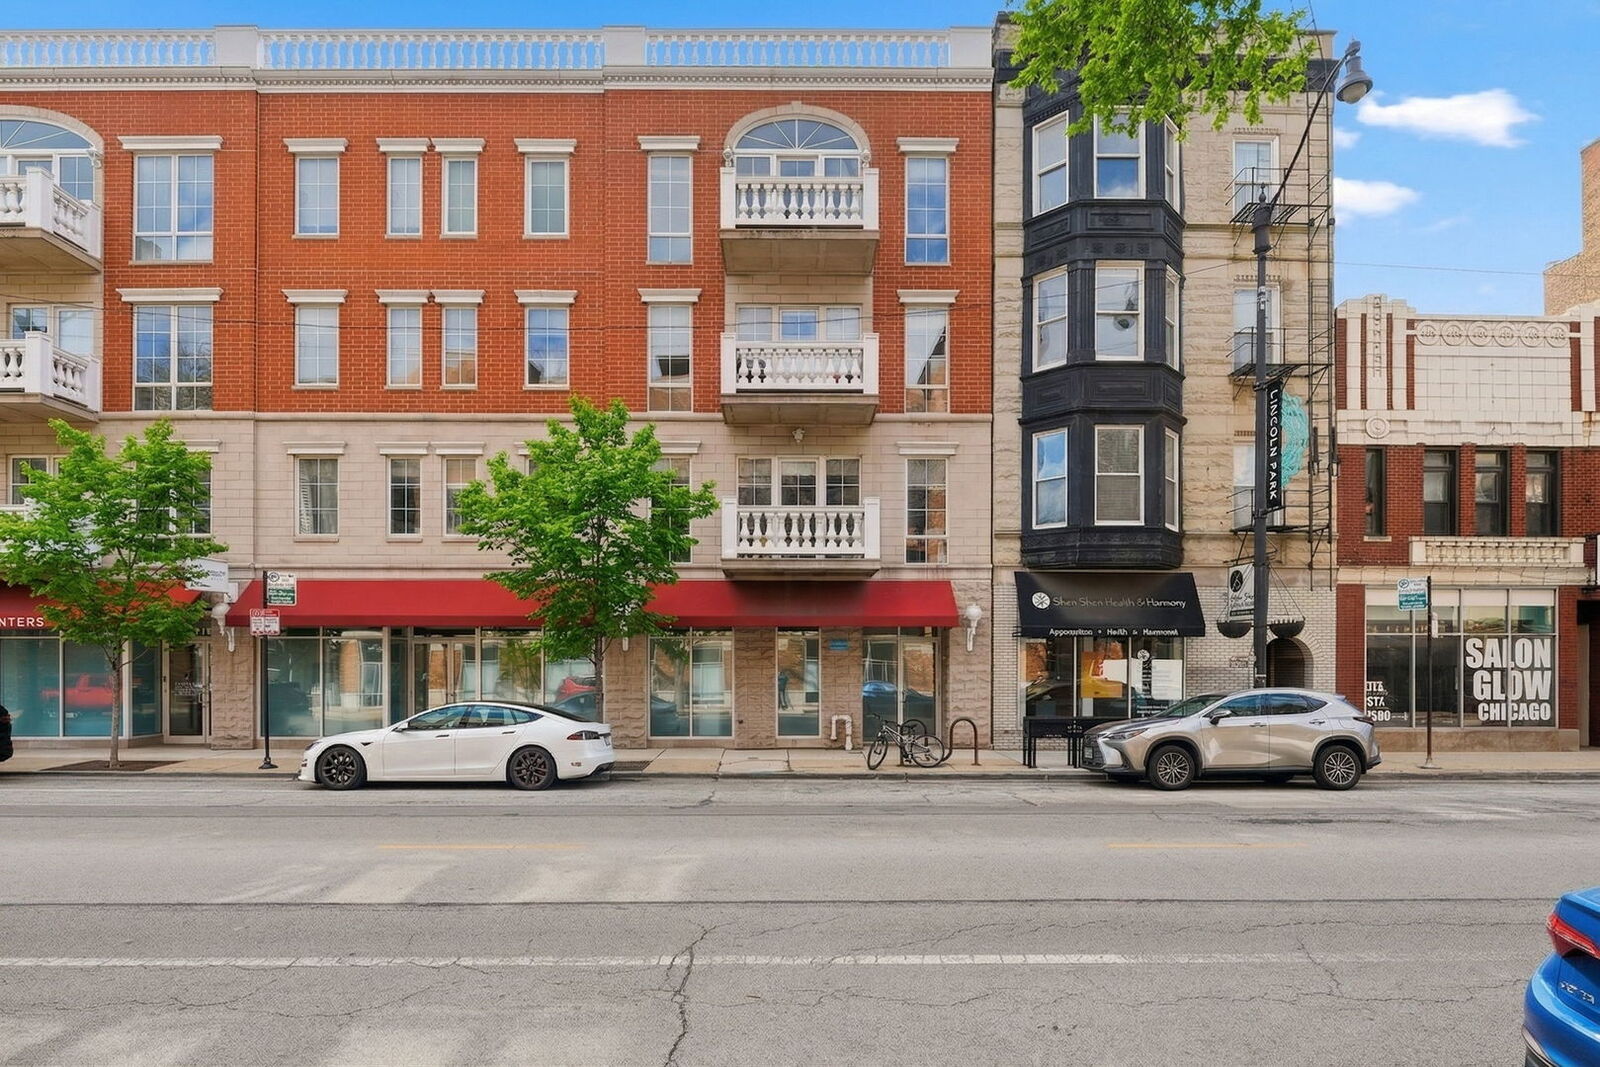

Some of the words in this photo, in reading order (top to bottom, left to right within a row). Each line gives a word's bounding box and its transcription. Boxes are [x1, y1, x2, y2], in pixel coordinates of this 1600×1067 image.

[1269, 389, 1279, 457] LINCOLN
[1269, 461, 1278, 500] PARK
[1052, 597, 1077, 607] Shen
[1078, 597, 1102, 607] Shen
[1104, 597, 1135, 608] Health
[1137, 597, 1146, 607] &
[1147, 597, 1187, 609] Harmony
[0, 617, 44, 627] NTERS
[1465, 637, 1551, 669] SALON
[1473, 670, 1552, 701] GLOW
[1478, 702, 1551, 721] CHICAGO
